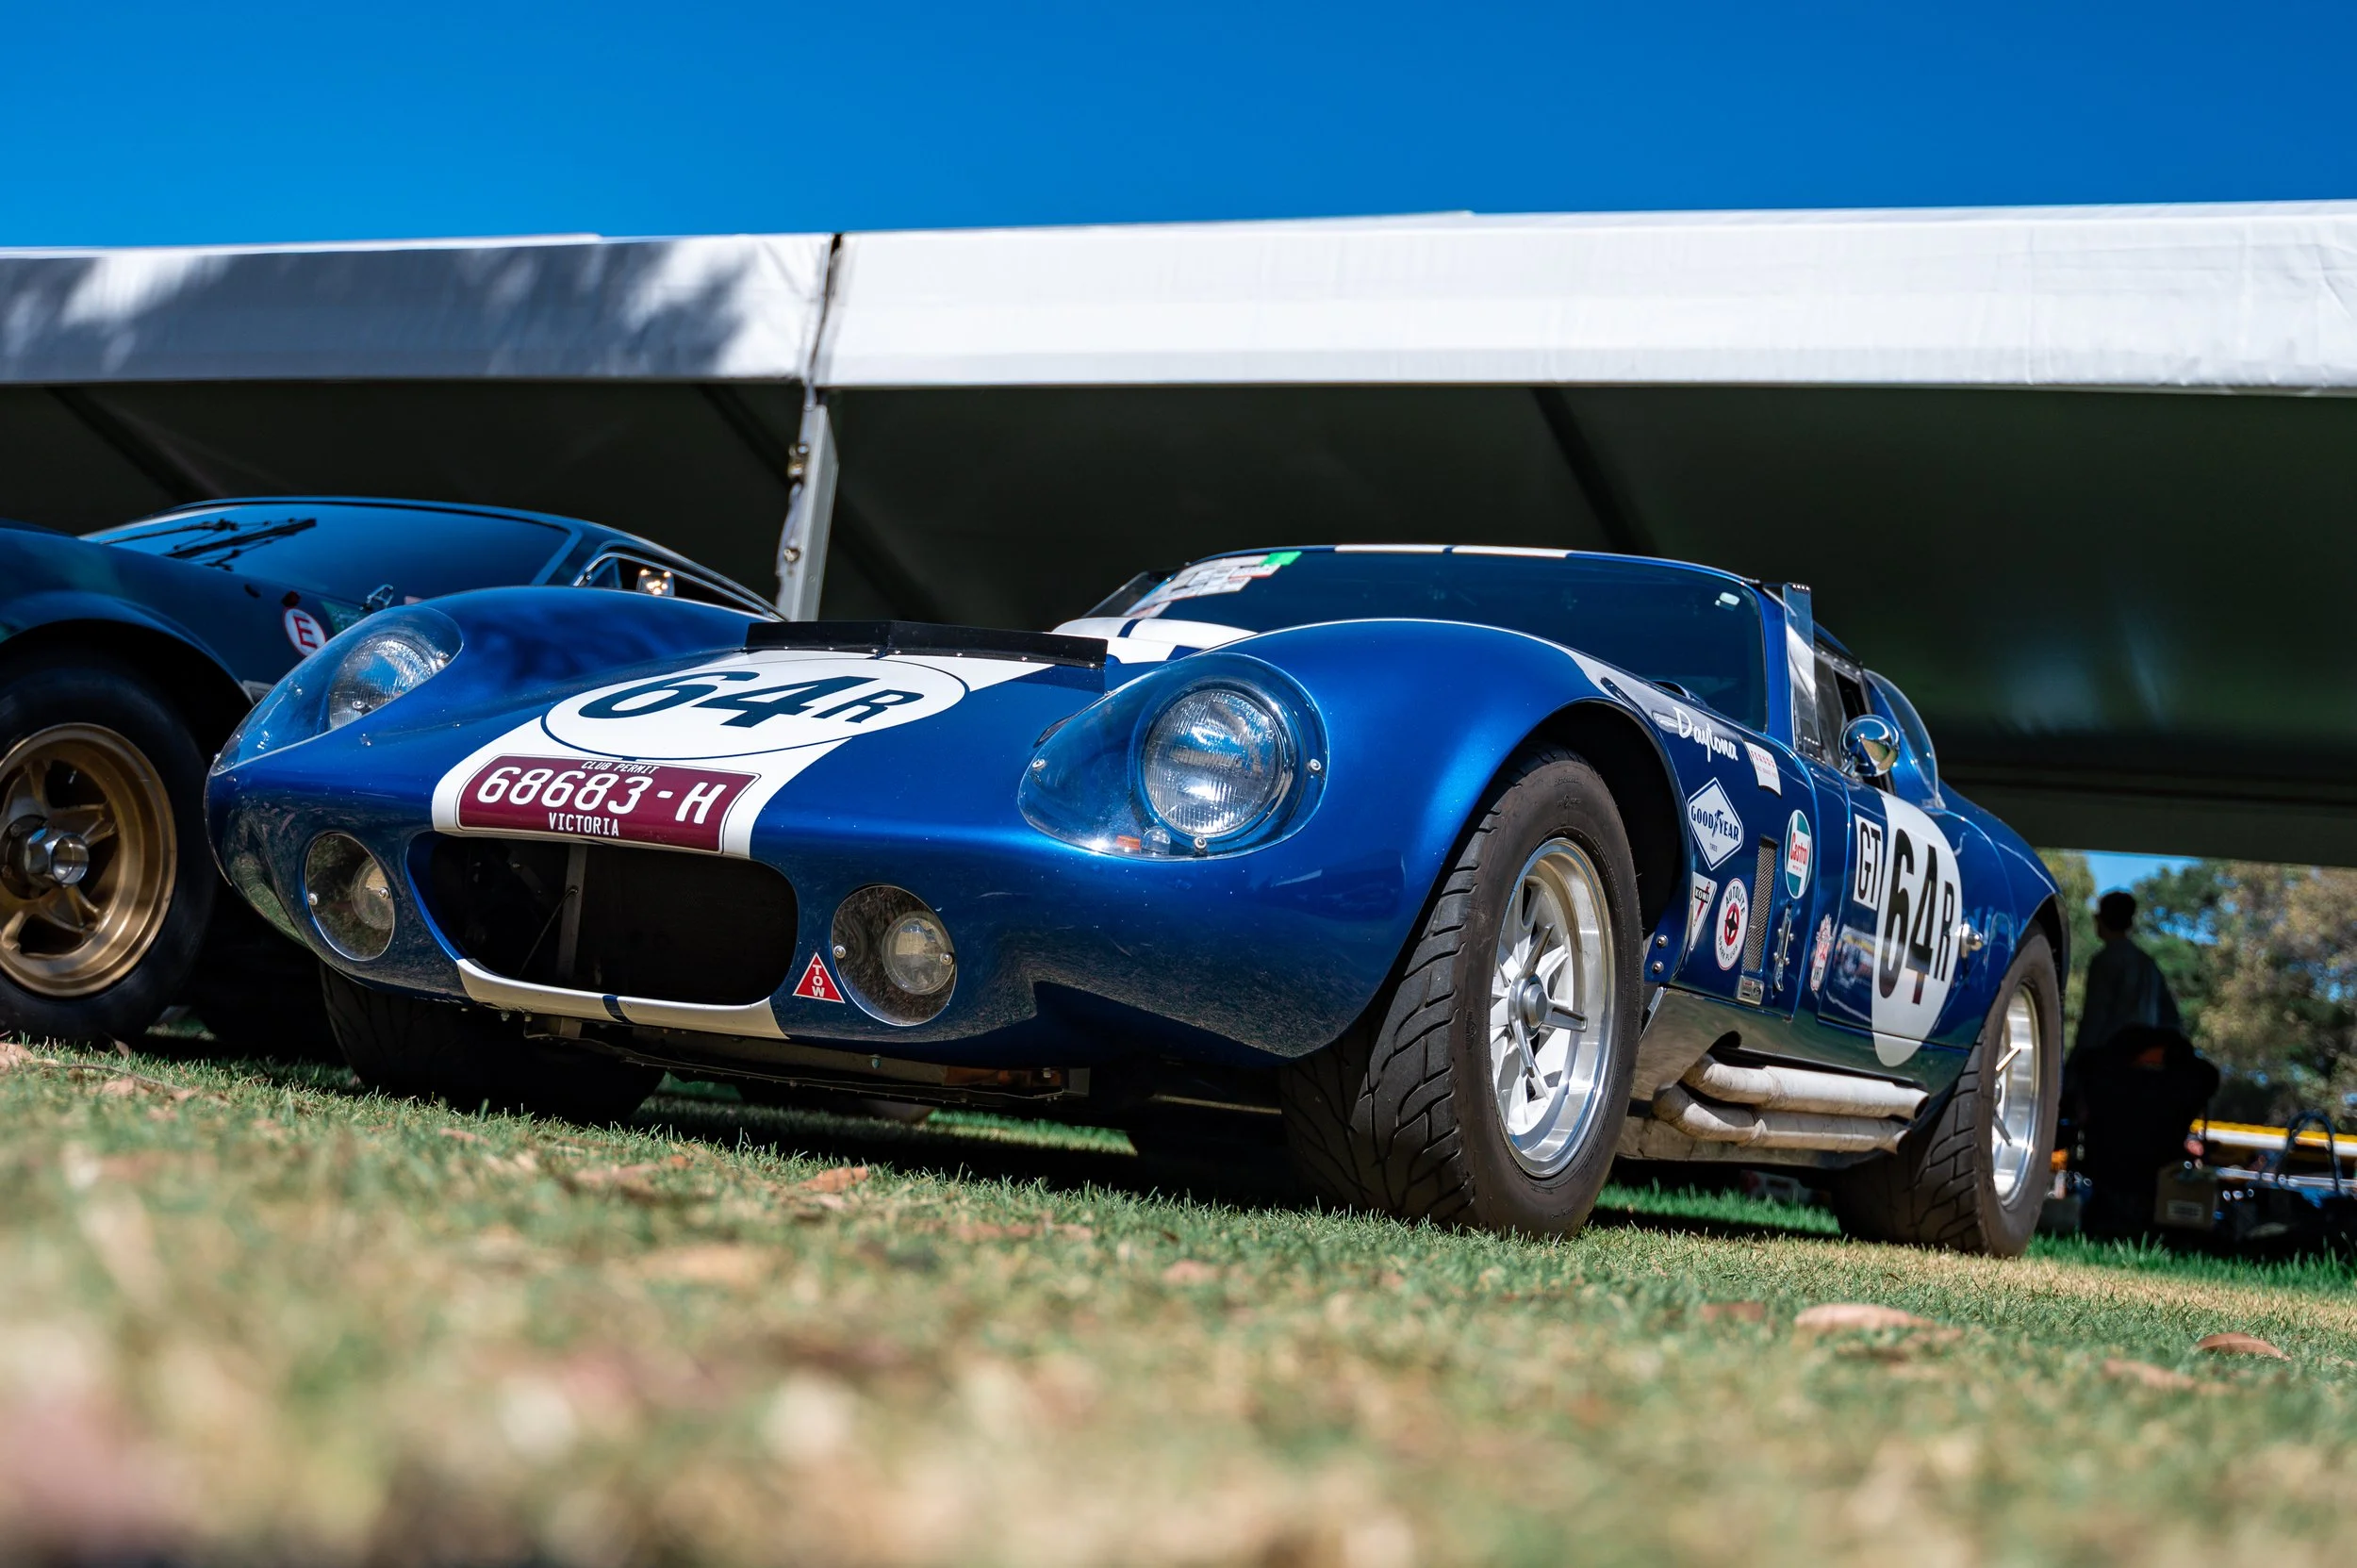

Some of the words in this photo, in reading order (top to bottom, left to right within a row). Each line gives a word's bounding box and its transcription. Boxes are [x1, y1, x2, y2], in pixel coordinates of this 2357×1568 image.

[293, 617, 317, 649] E
[1673, 706, 1739, 762] Daytona
[581, 760, 611, 771] CLUB
[614, 762, 660, 774] PERMIT
[549, 812, 619, 837] VICTORIA
[1690, 805, 1739, 842] GOODYEAR
[1790, 832, 1810, 866] Castrol
[1857, 821, 1882, 903] GT
[1725, 886, 1745, 915] AUTOLITE
[811, 964, 826, 998] TOW
